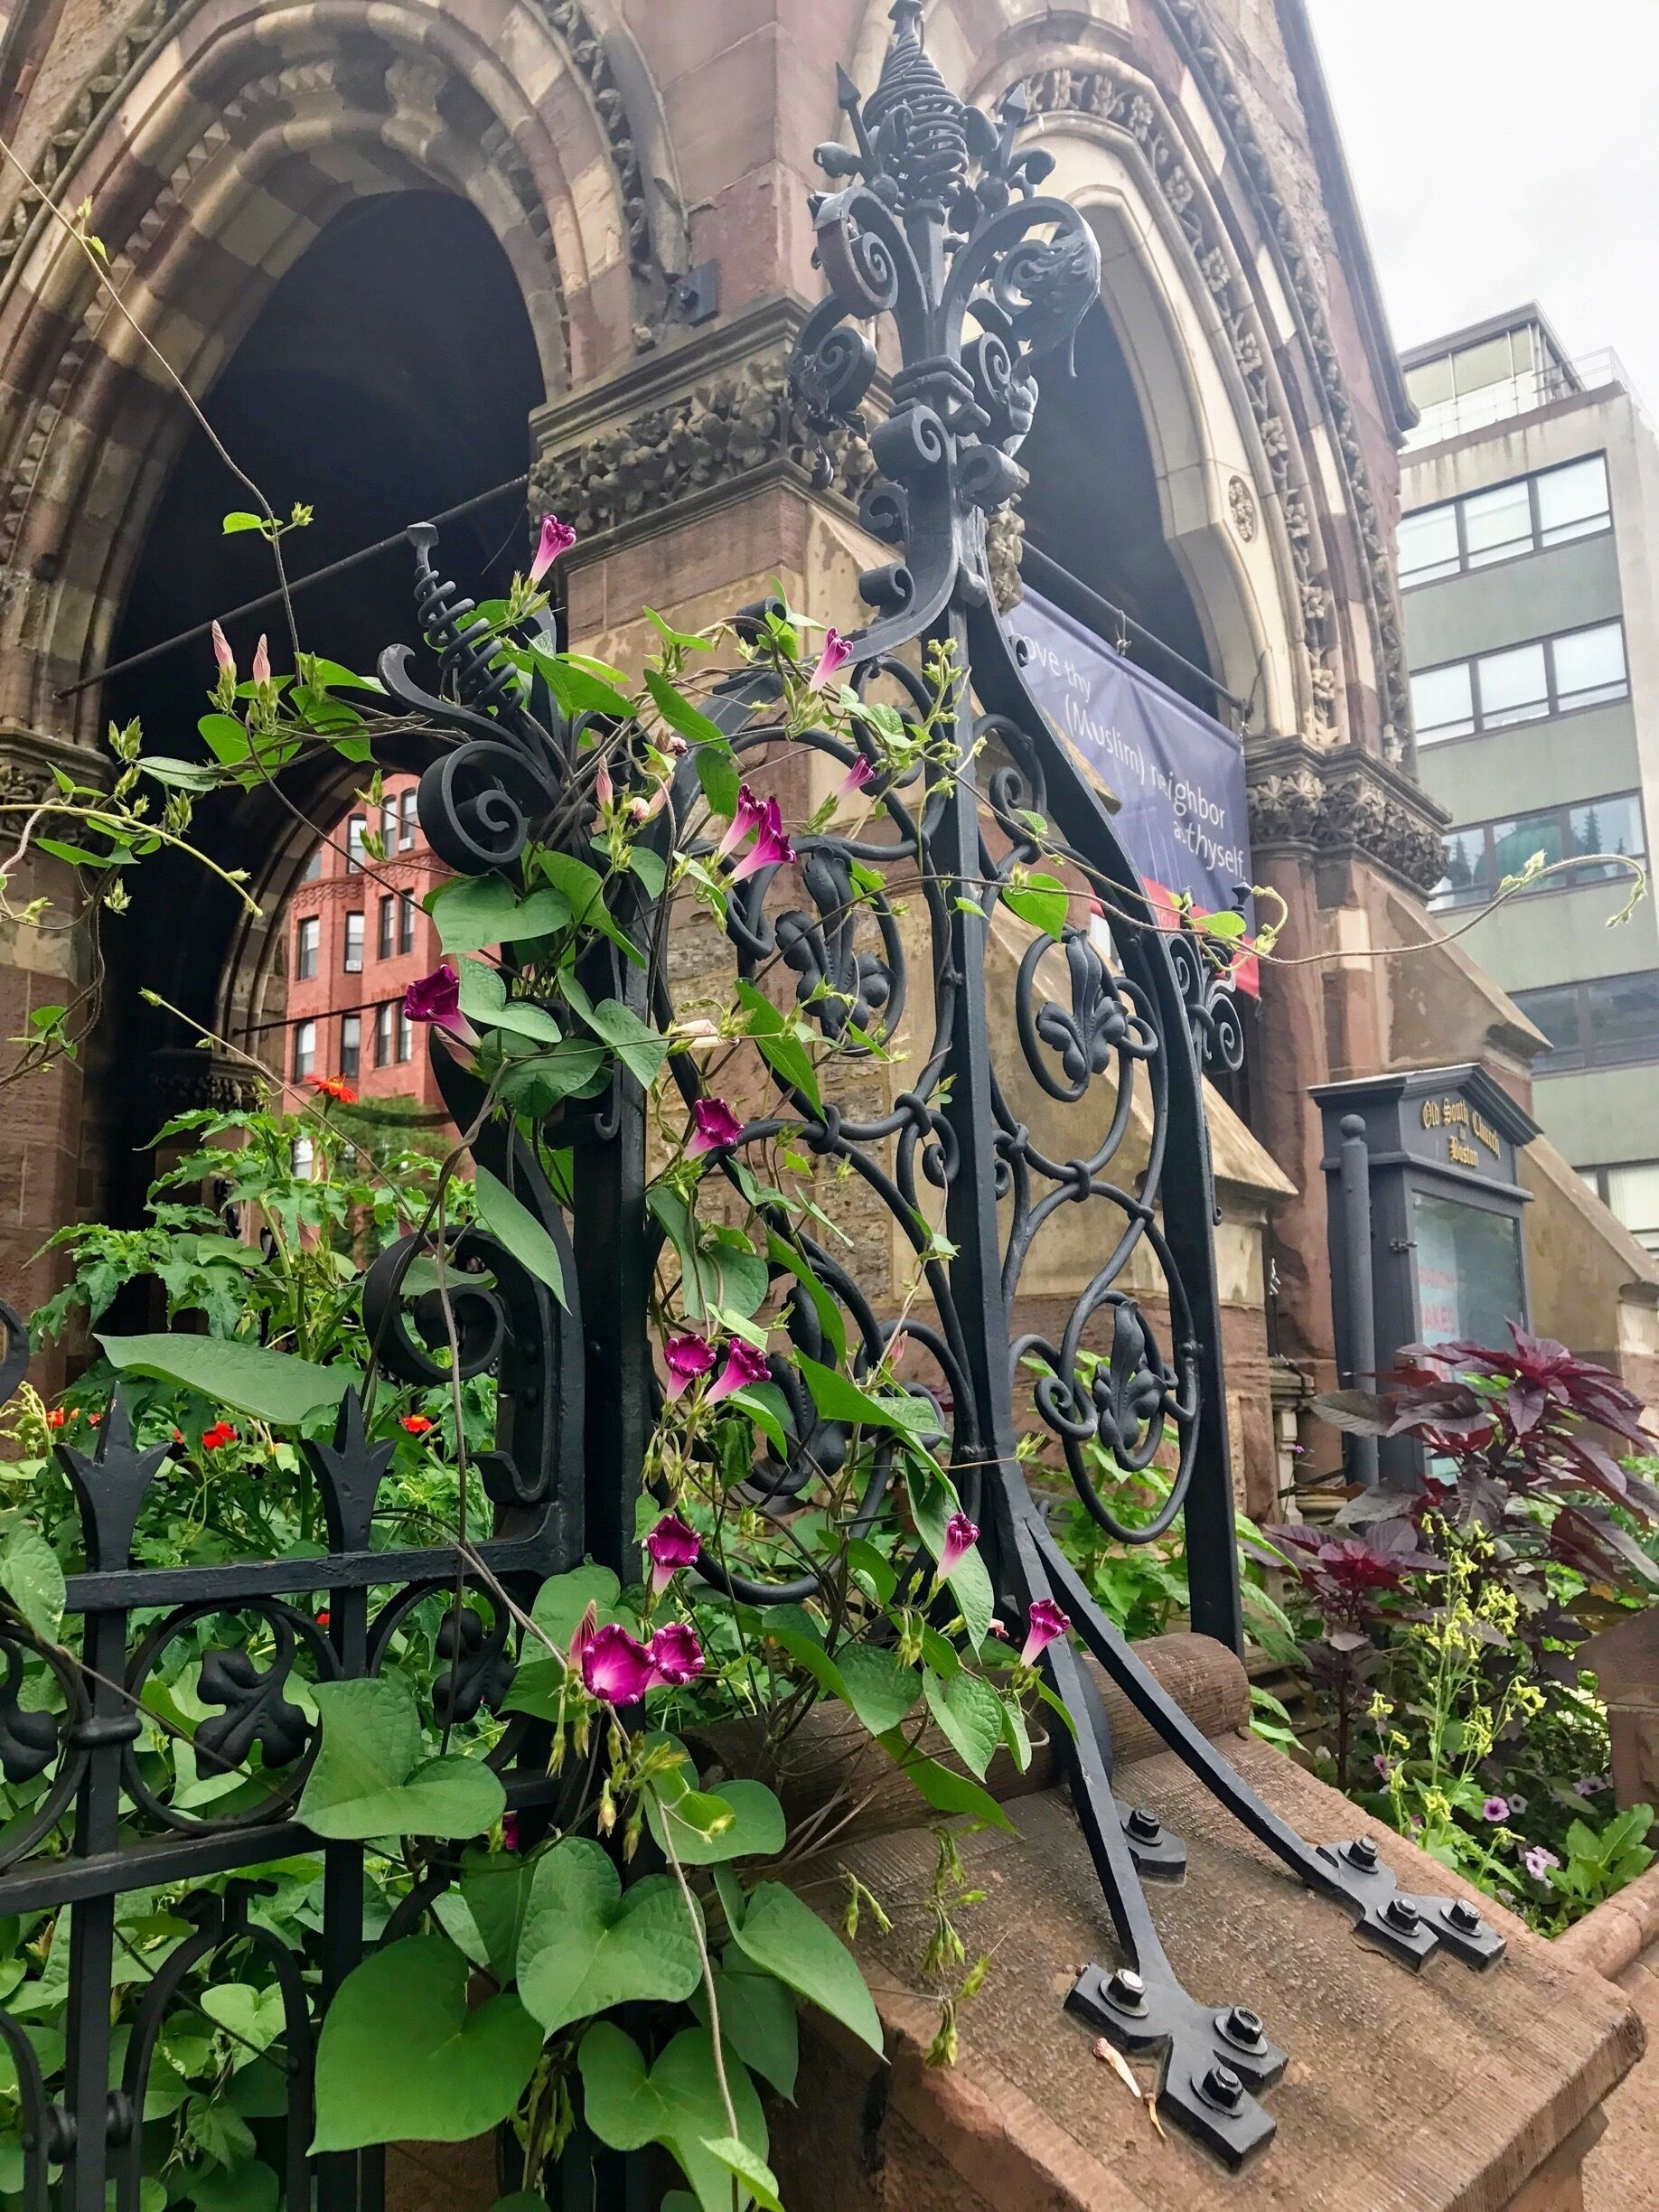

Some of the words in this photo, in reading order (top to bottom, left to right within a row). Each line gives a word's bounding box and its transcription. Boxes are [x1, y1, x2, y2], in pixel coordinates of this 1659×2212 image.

[1064, 661, 1091, 703] thy
[1065, 693, 1145, 786] (Muslim)
[1151, 764, 1225, 830] neighbor
[1186, 822, 1247, 881] thyself.
[1422, 1101, 1439, 1129] Old
[1443, 1097, 1468, 1127] South
[1472, 1111, 1500, 1159] Church
[1448, 1135, 1479, 1167] Boston
